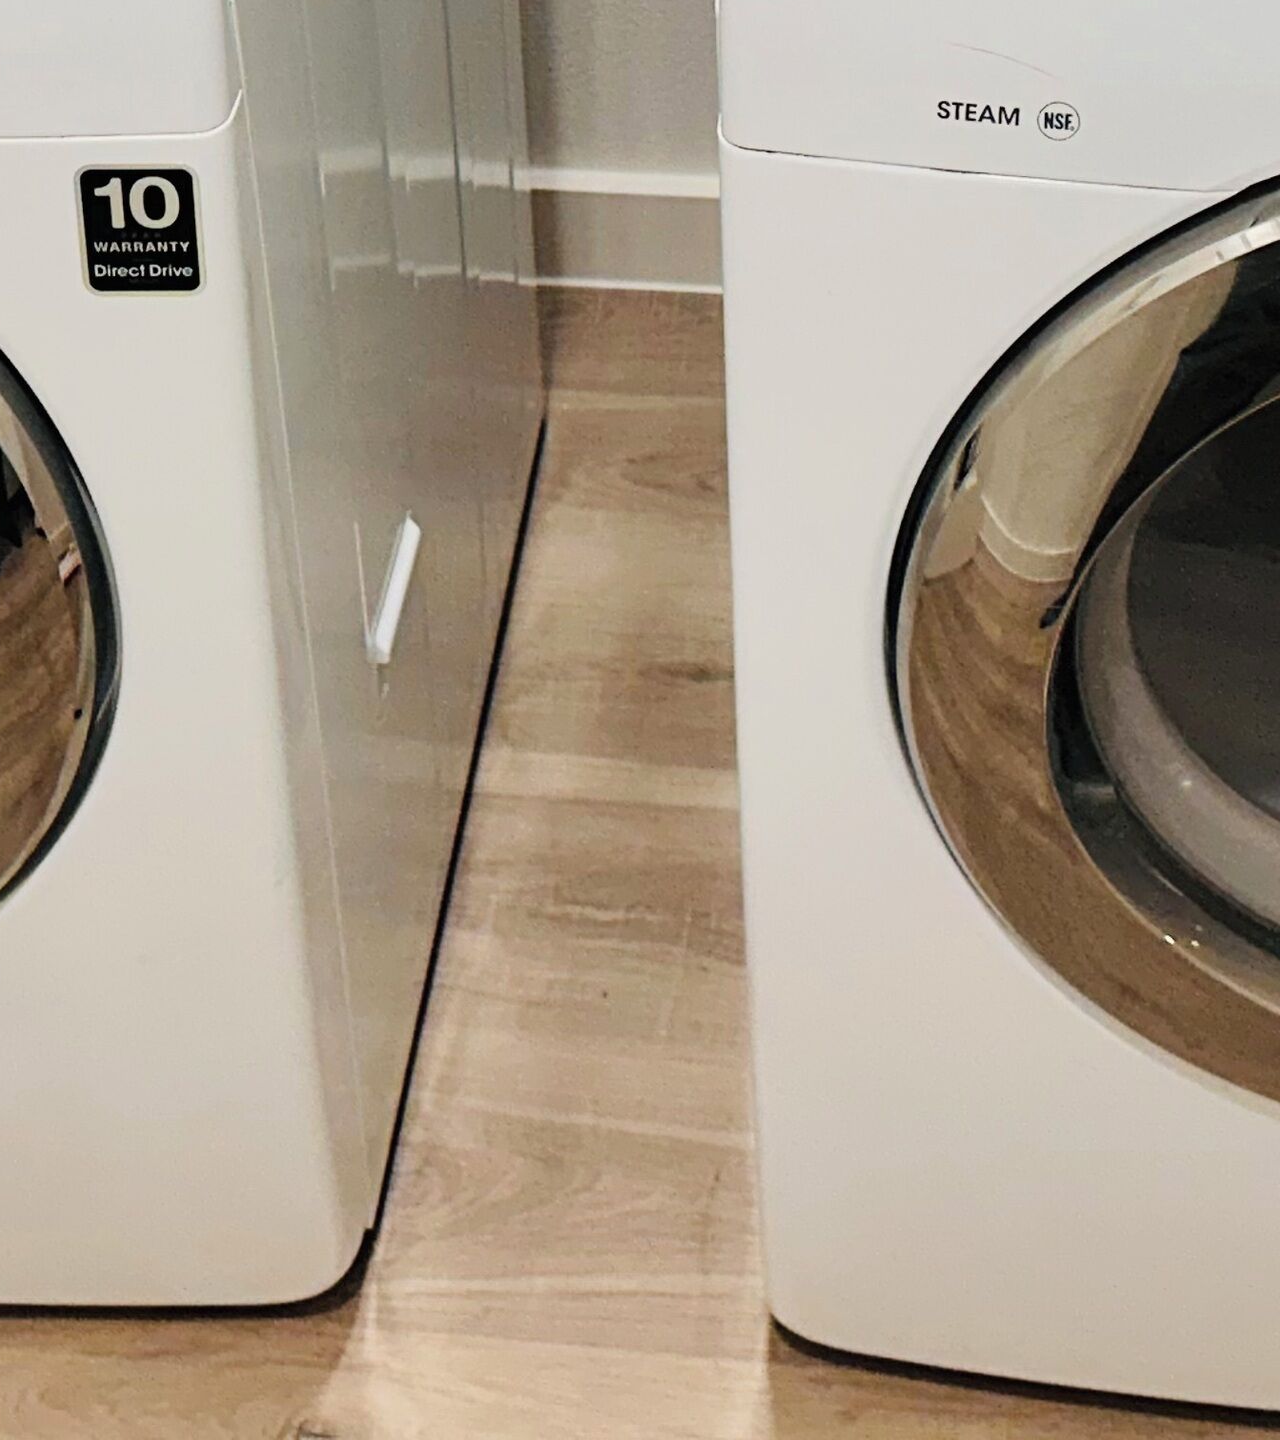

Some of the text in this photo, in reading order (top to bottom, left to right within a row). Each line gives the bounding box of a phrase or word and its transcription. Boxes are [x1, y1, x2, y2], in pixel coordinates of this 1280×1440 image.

[937, 101, 1073, 131] STEAM NSF
[94, 177, 179, 228] 10
[94, 242, 189, 253] WARRANTY
[95, 265, 192, 276] Direct Drive
